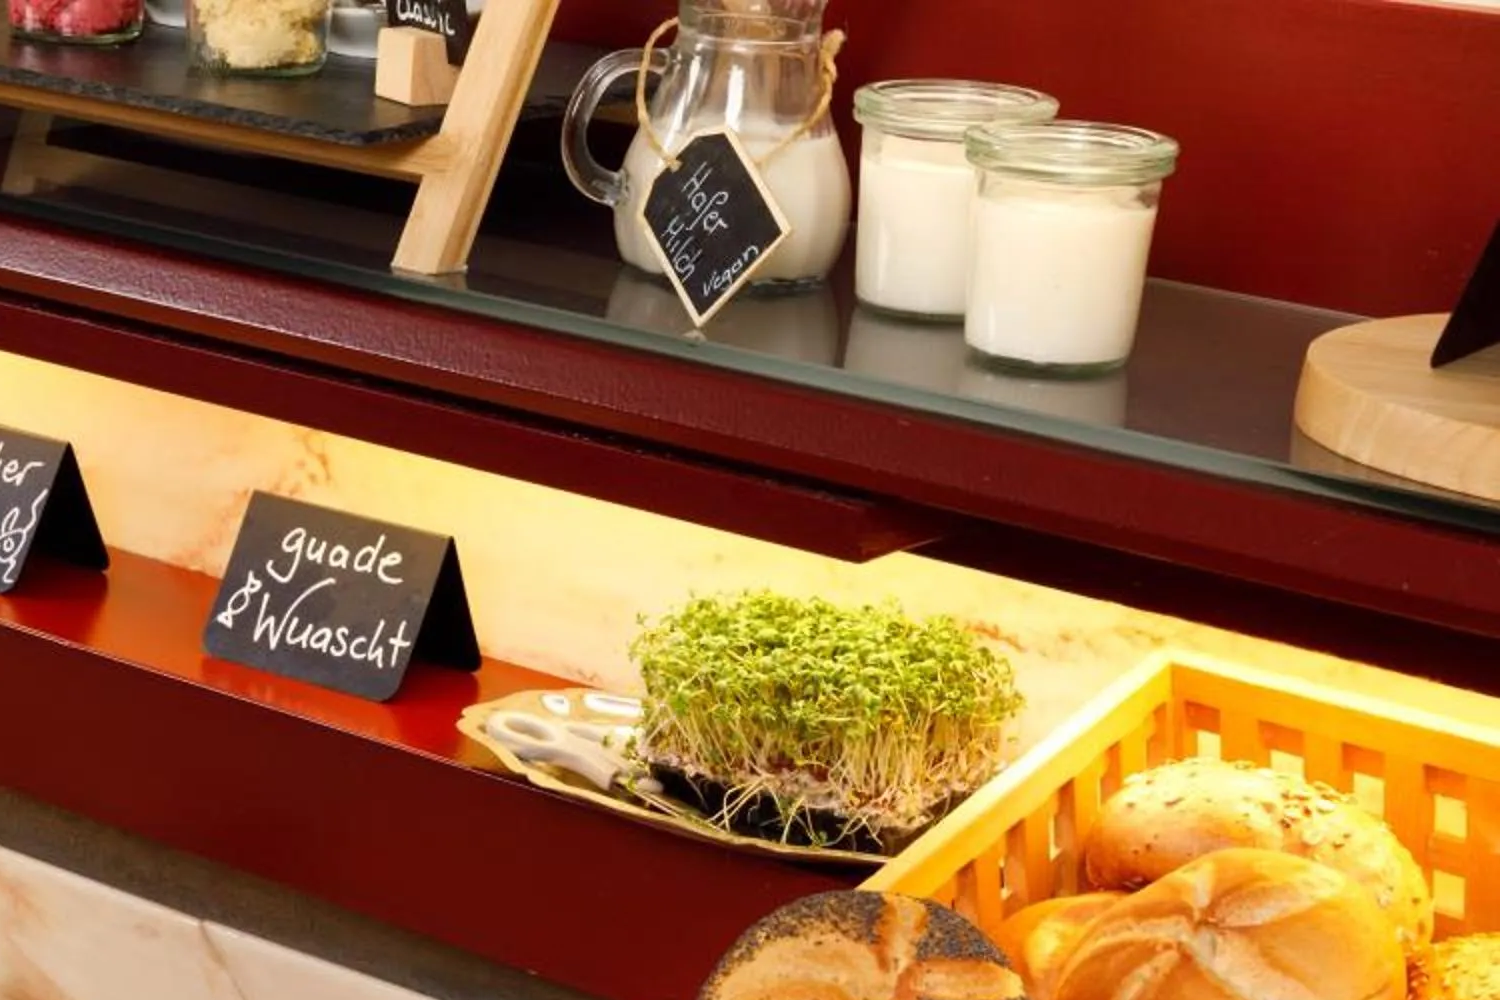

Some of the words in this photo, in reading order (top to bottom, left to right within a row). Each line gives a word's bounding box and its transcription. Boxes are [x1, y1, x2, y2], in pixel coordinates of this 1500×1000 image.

[681, 160, 729, 235] Hafer
[267, 527, 403, 584] guade
[254, 577, 411, 668] Wuascht
